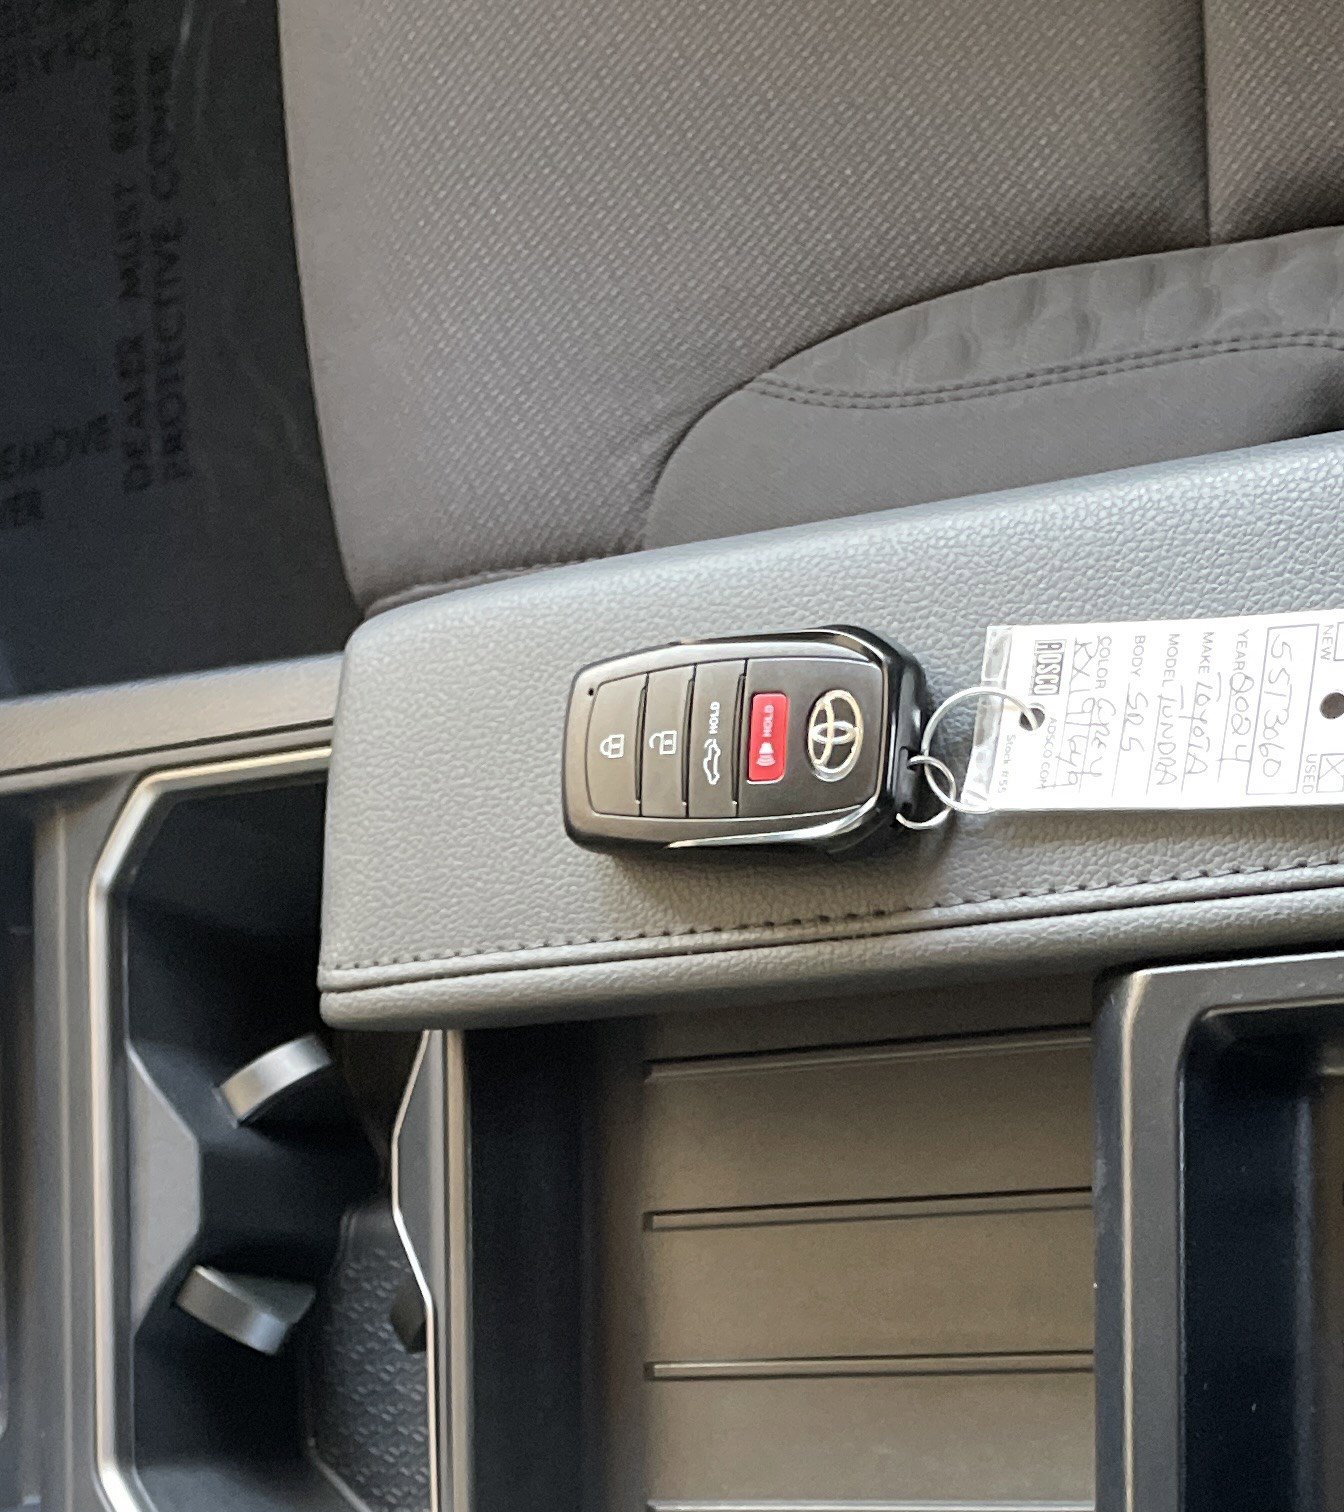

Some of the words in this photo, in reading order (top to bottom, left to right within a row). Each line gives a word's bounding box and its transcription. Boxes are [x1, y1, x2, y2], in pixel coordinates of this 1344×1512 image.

[1094, 635, 1113, 690] COLOR
[1130, 634, 1146, 678] BODY
[1161, 632, 1181, 688] MODEL
[1197, 631, 1215, 674] MAKE
[1233, 628, 1251, 671] YEAR
[1320, 624, 1336, 661] NEW
[1031, 639, 1065, 696] ADSCO
[708, 701, 721, 735] HOLD
[762, 704, 775, 738] HOLD
[1216, 671, 1256, 764] 2024
[1003, 734, 1017, 765] Stock
[1301, 752, 1318, 795] USED
